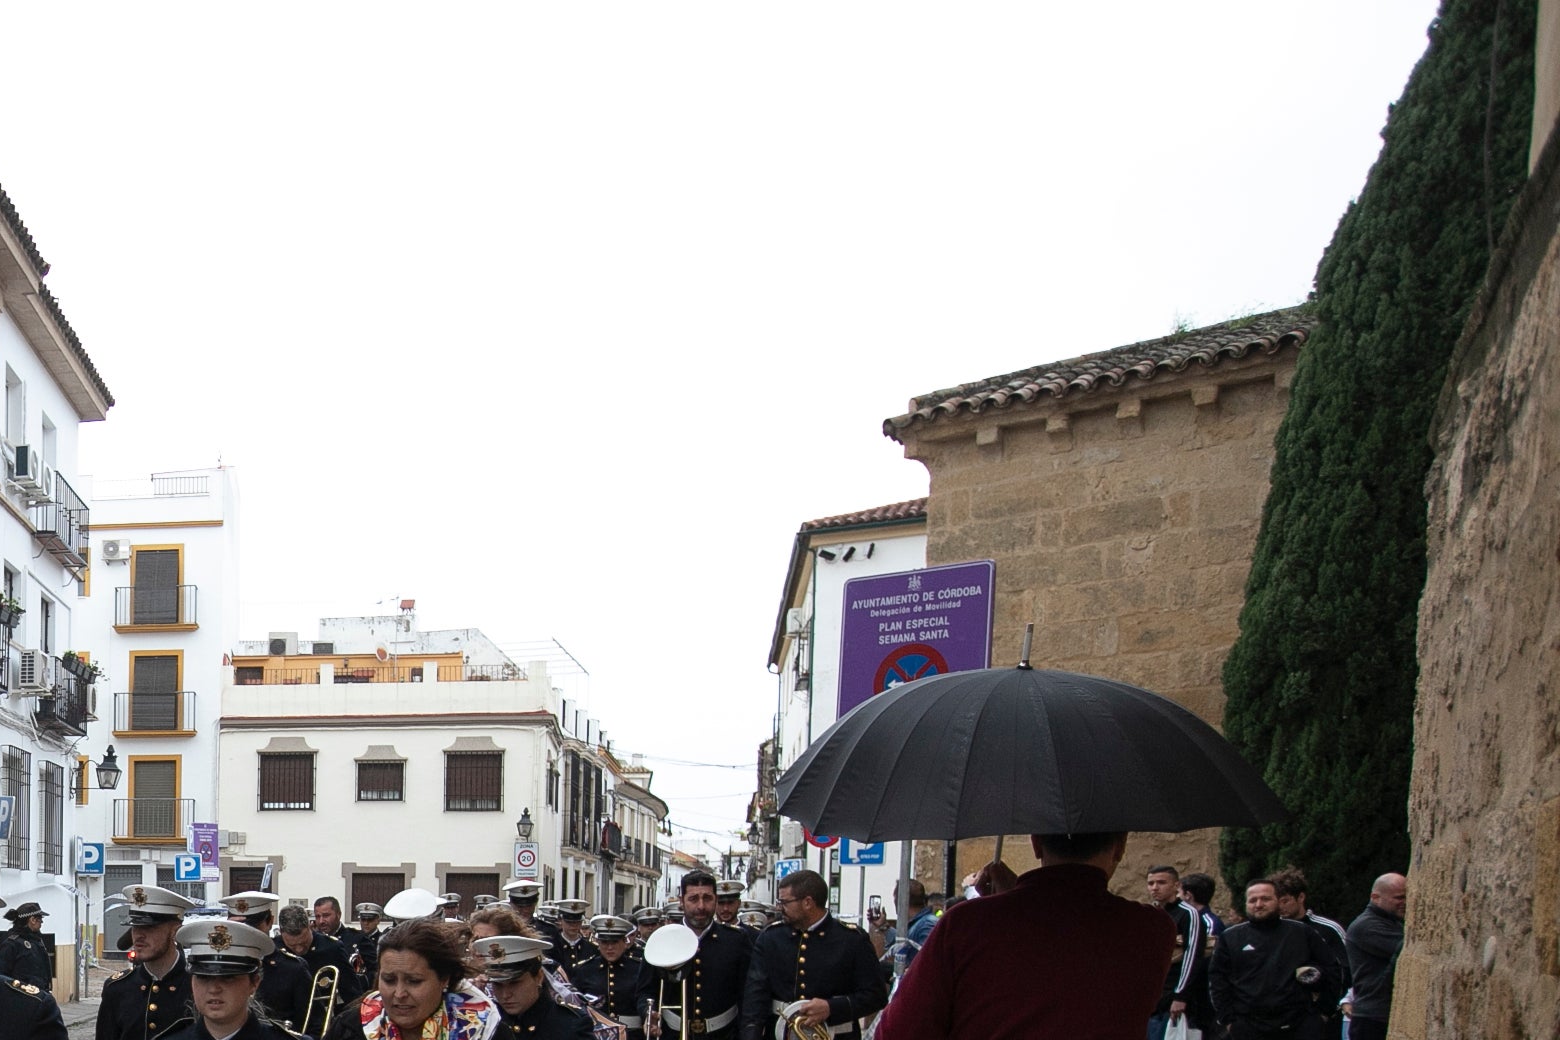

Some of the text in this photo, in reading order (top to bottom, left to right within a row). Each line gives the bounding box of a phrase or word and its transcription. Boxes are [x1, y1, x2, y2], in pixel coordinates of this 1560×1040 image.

[852, 585, 982, 610] AYUNTAMIENTO DE CÓRDOBA
[870, 600, 962, 618] Delegación de Movilidad
[879, 616, 950, 632] PLAN ESPECIAL
[878, 629, 950, 645] SEMANA SANTA
[83, 845, 99, 872] P
[179, 857, 196, 879] P
